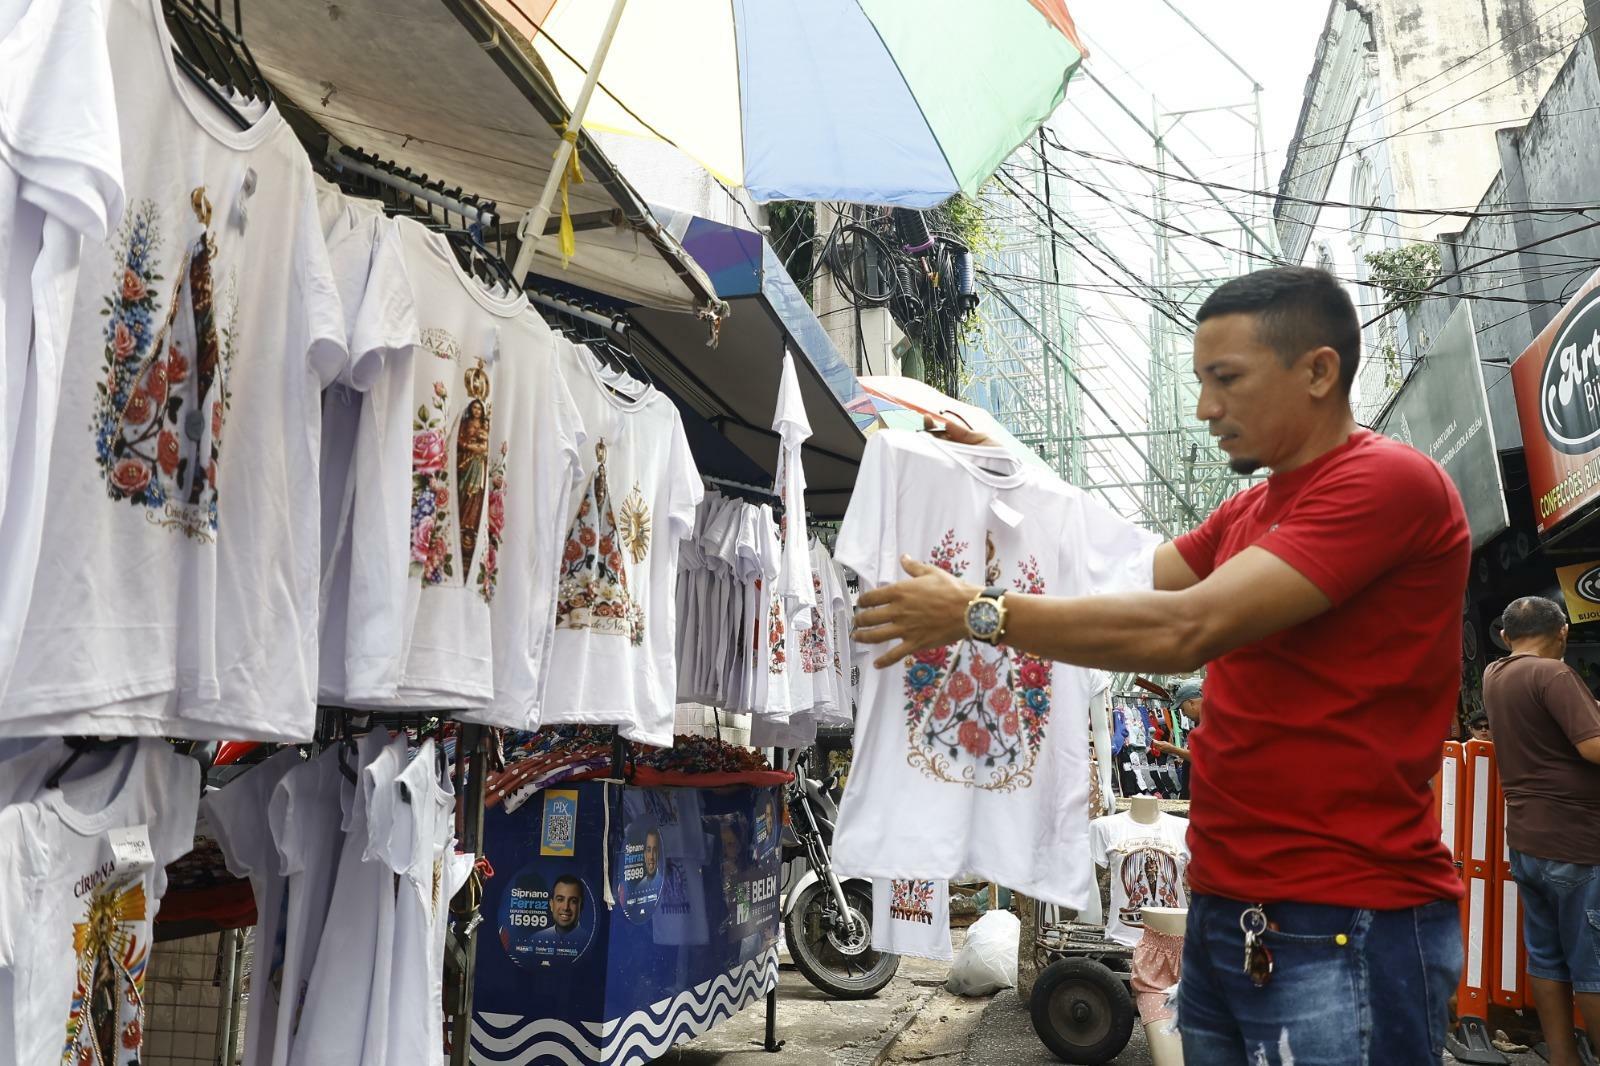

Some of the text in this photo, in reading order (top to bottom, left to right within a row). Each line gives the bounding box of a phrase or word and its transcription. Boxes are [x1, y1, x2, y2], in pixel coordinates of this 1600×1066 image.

[1540, 470, 1587, 519] CONFECÇÕES,
[553, 801, 569, 816] PIX
[624, 867, 644, 881] 15999
[511, 888, 549, 899] Sipriano
[752, 873, 777, 904] BELÉM
[510, 898, 548, 909] Ferraz
[509, 914, 548, 927] 15999
